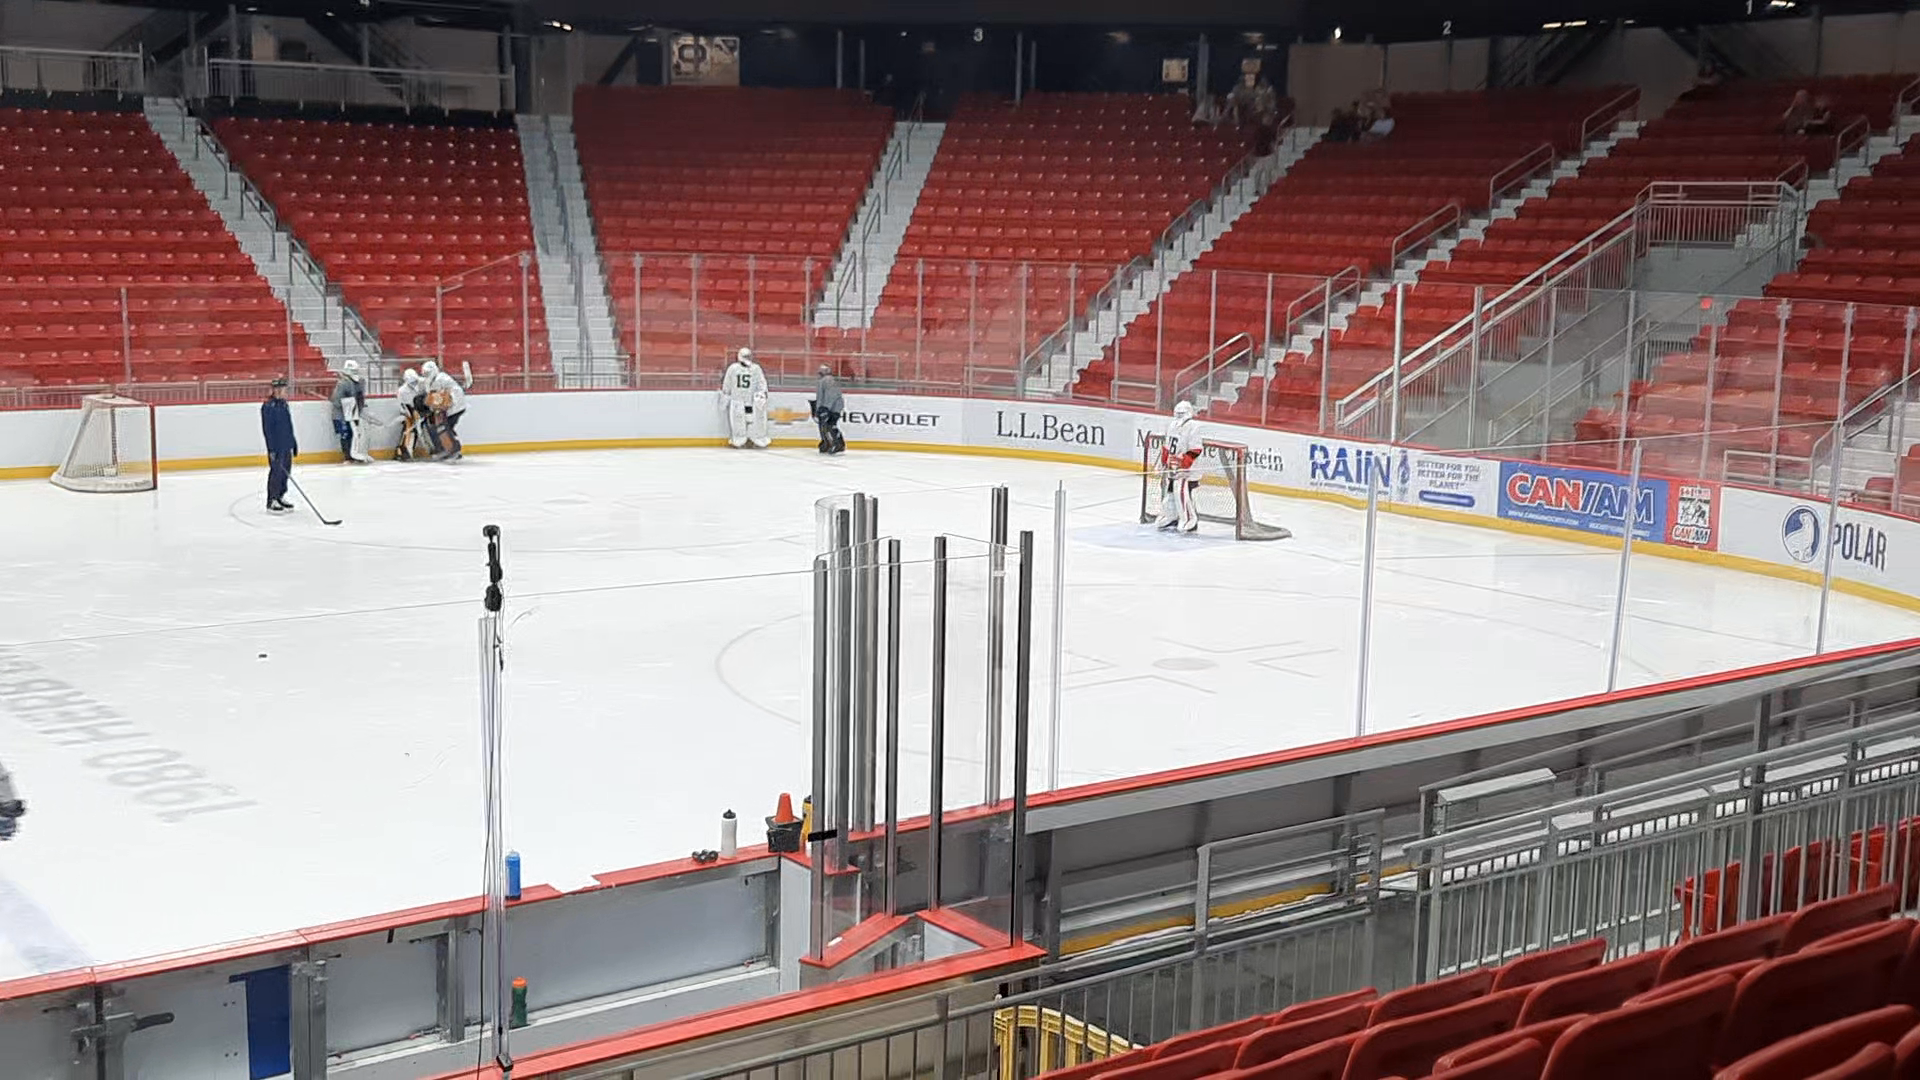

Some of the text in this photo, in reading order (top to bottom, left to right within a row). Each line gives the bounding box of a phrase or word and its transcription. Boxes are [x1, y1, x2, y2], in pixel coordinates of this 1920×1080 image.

[973, 28, 983, 42] 3
[1443, 20, 1452, 35] 2
[736, 374, 751, 389] 15
[840, 410, 940, 427] HEVROLET
[996, 410, 1105, 446] L.L.Bean
[1309, 443, 1392, 488] RAIN
[1831, 522, 1887, 573] POLAR
[81, 748, 258, 824] 1980
